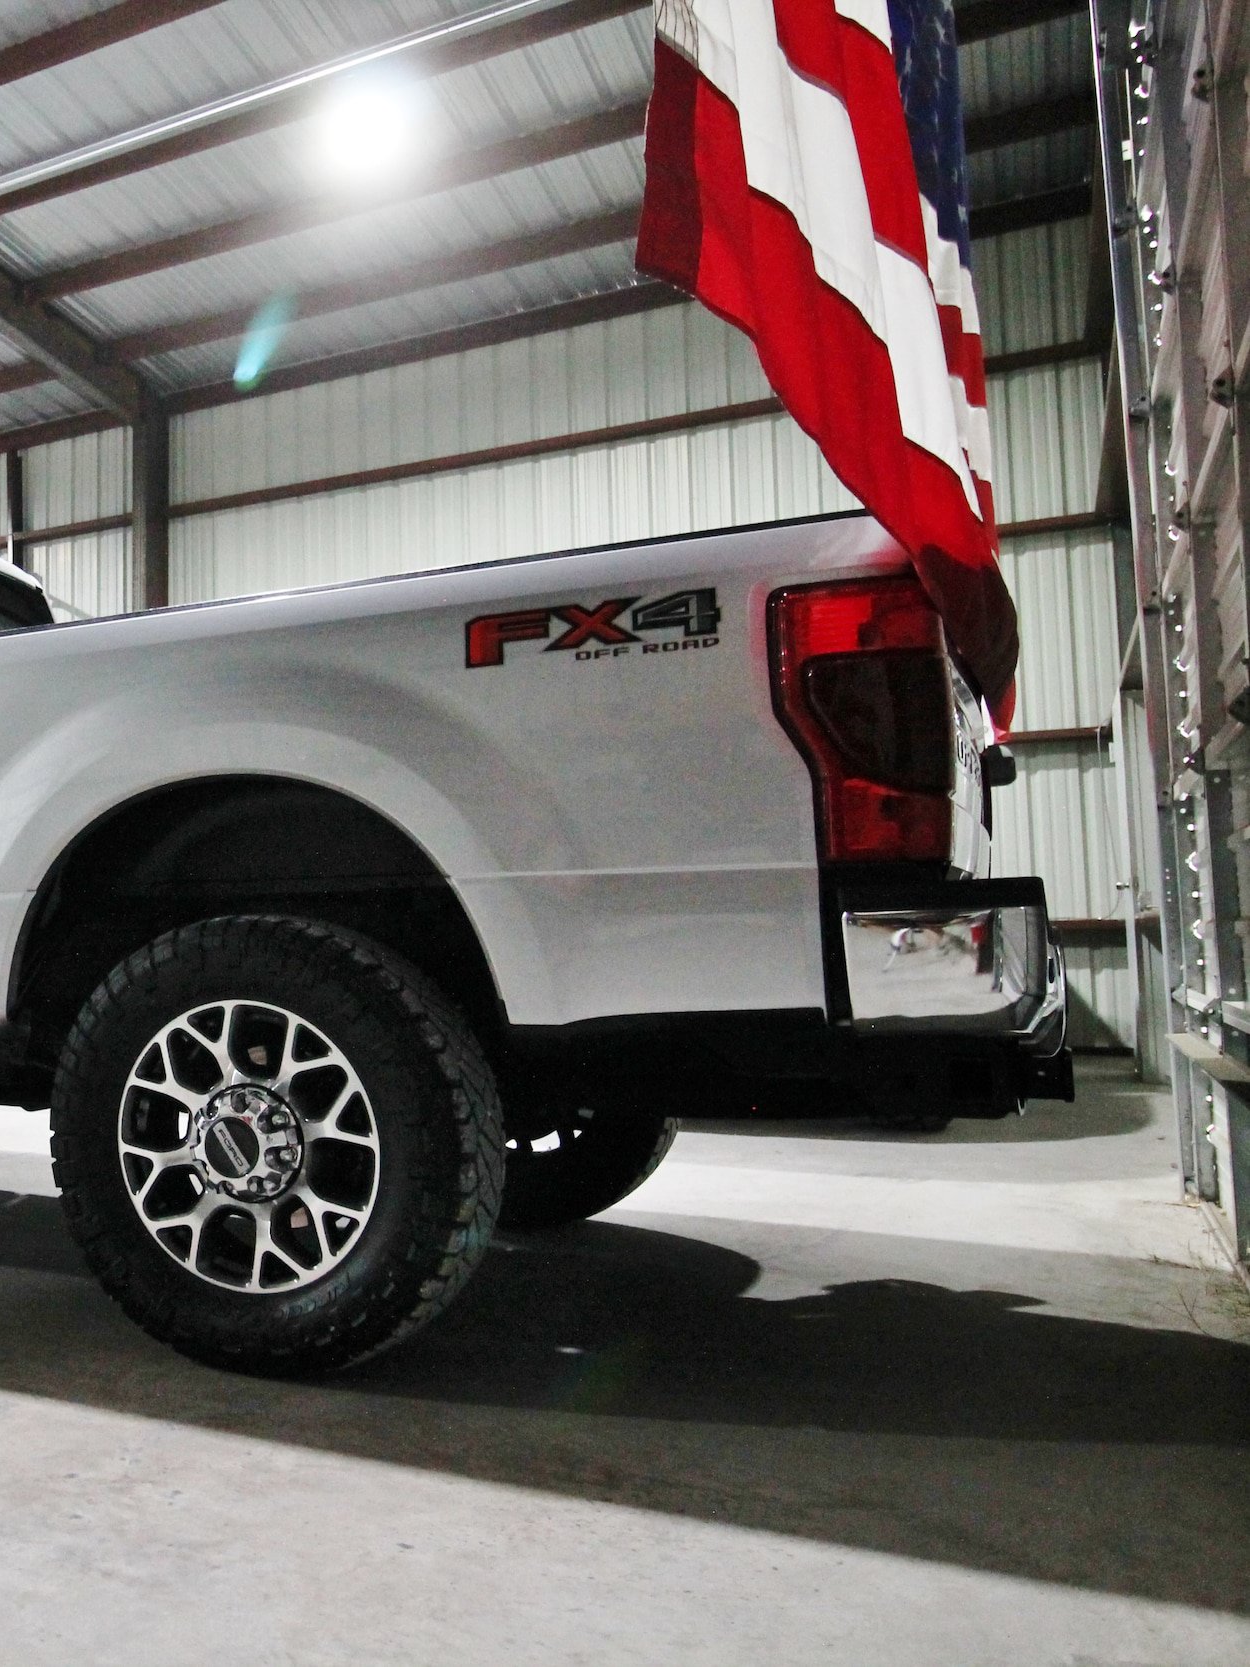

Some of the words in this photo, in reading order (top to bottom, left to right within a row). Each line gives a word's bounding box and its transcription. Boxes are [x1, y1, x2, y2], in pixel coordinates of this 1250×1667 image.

[465, 587, 721, 669] FX4
[575, 646, 630, 661] OFF
[642, 637, 720, 656] ROAD
[218, 1128, 244, 1167] FORD
